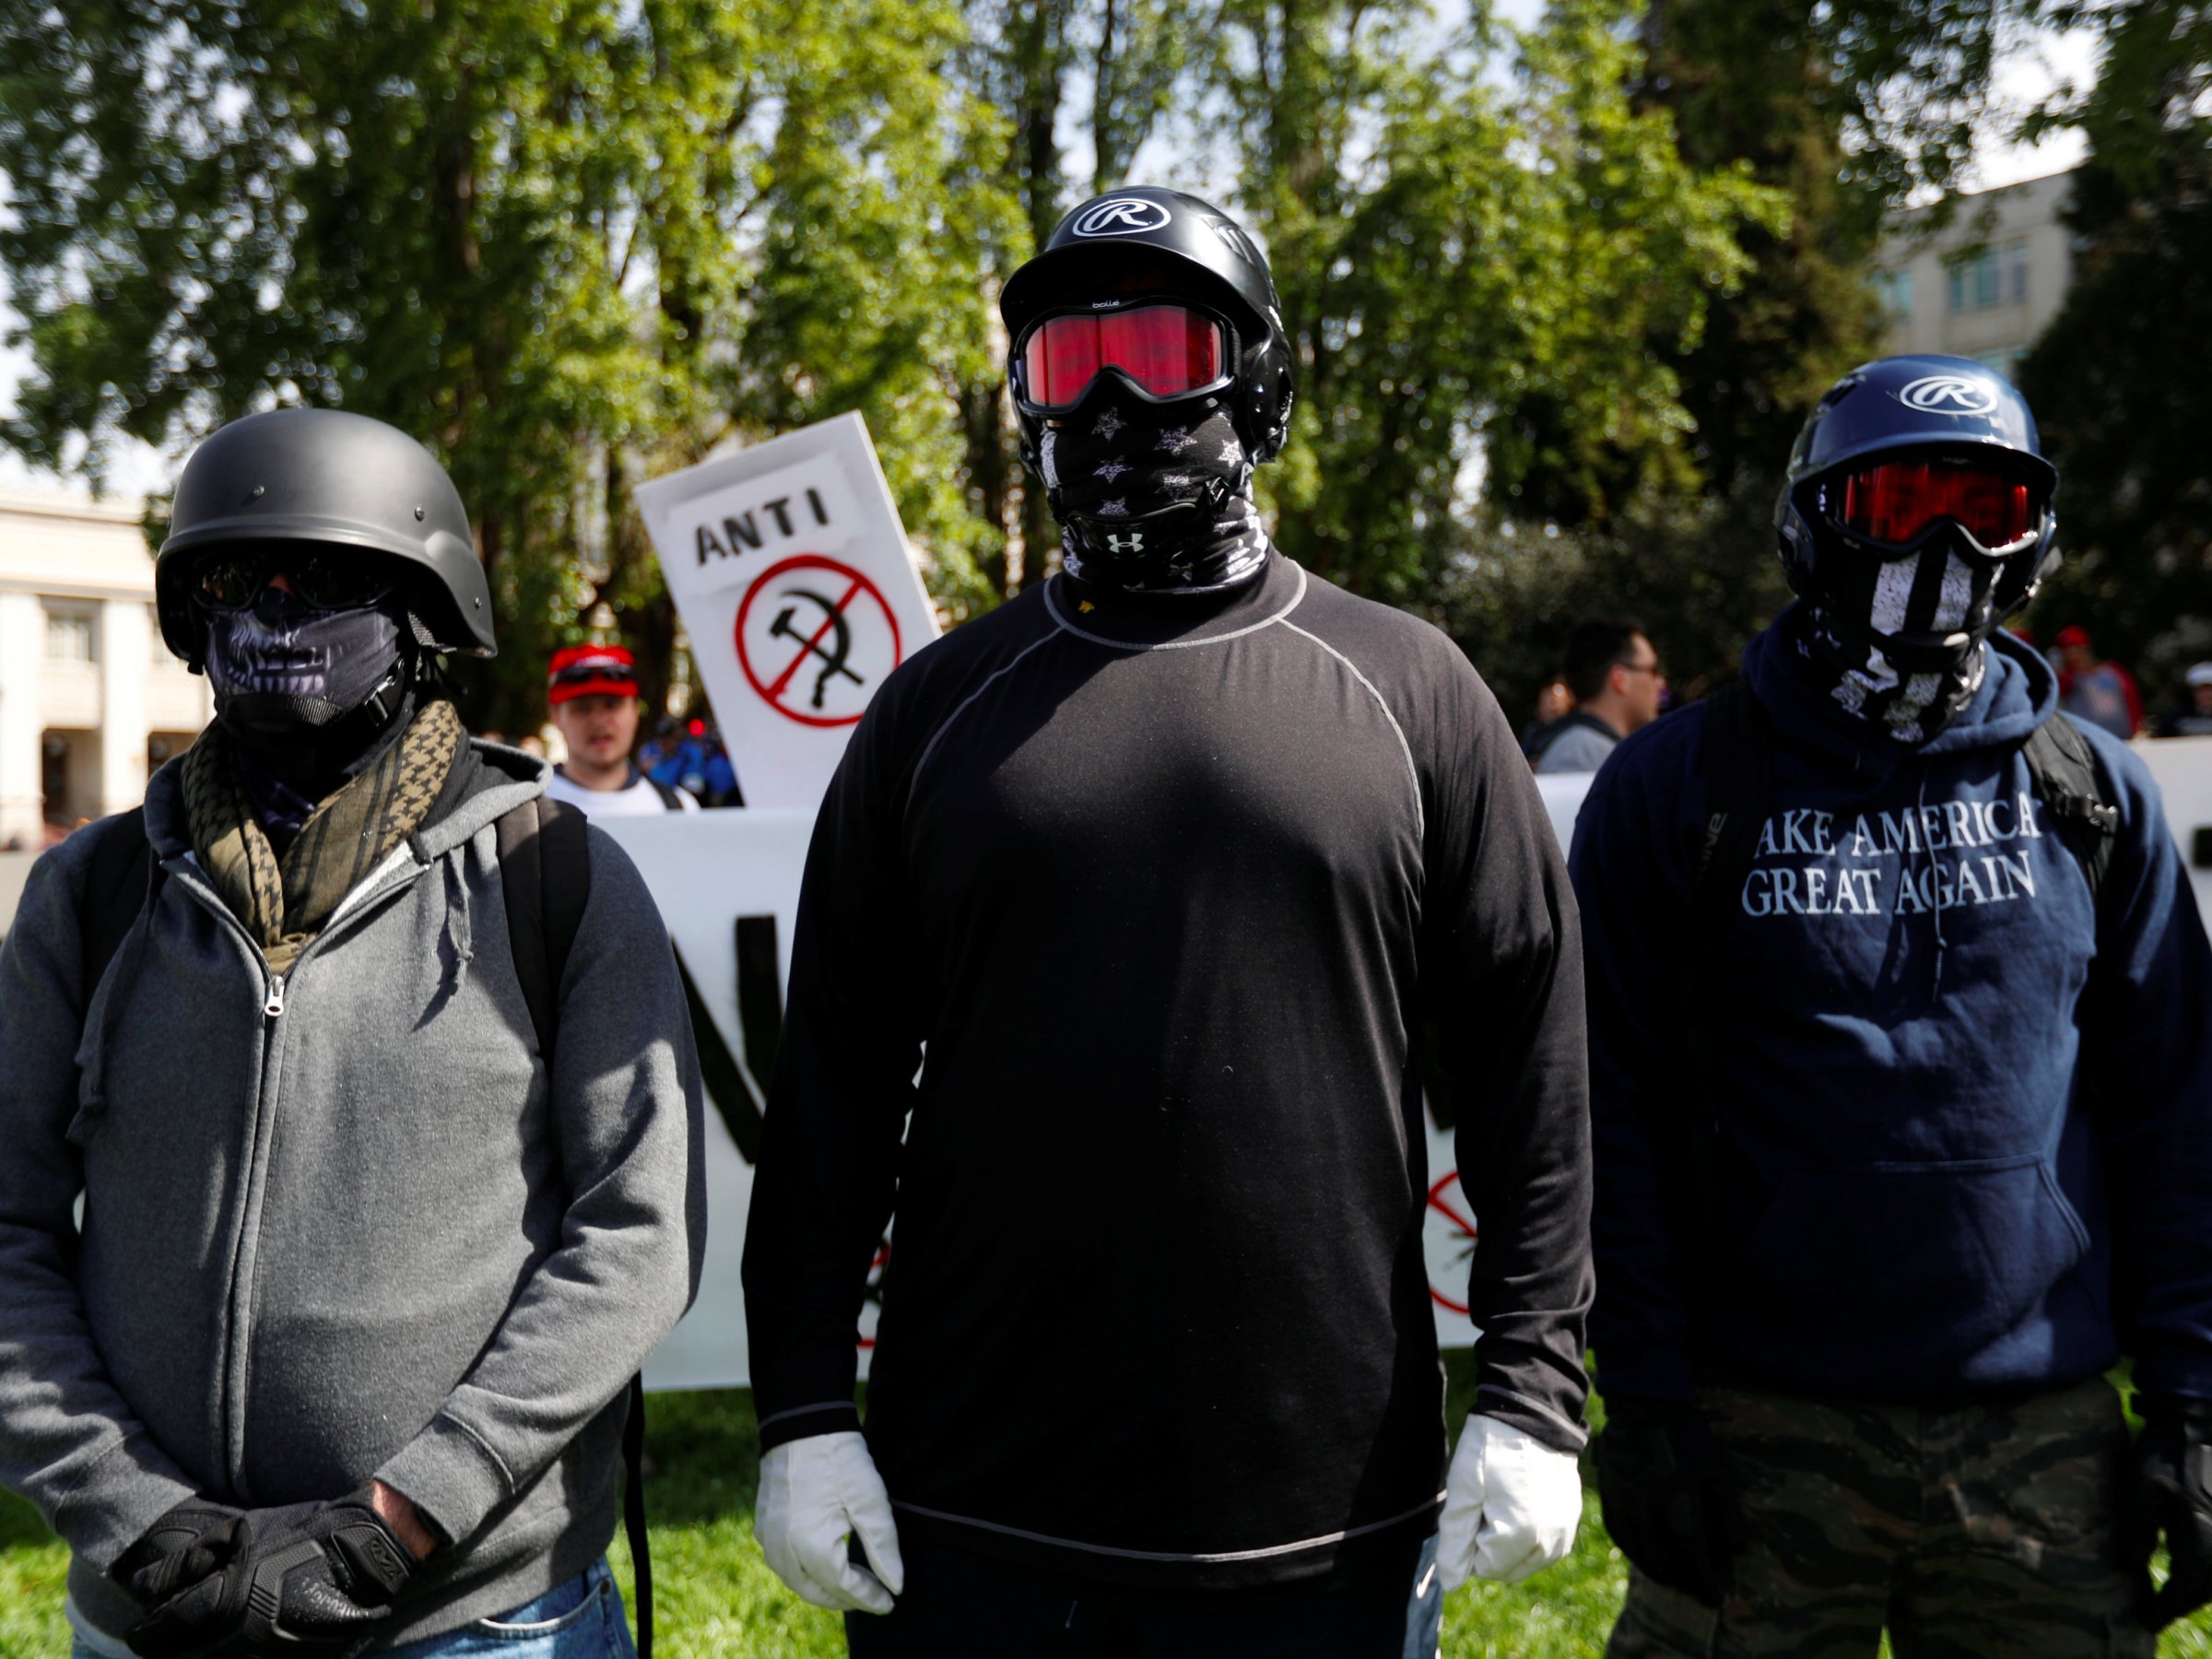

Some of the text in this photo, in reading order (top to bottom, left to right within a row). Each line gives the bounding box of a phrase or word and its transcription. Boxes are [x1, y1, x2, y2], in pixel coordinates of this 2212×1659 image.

[1083, 201, 1150, 232] R
[1912, 381, 1980, 409] R
[695, 488, 829, 567] ANTI
[1754, 807, 1836, 859] AKE
[1851, 791, 2042, 857] AMERICA
[1741, 850, 2036, 917] GREAT AGAIN
